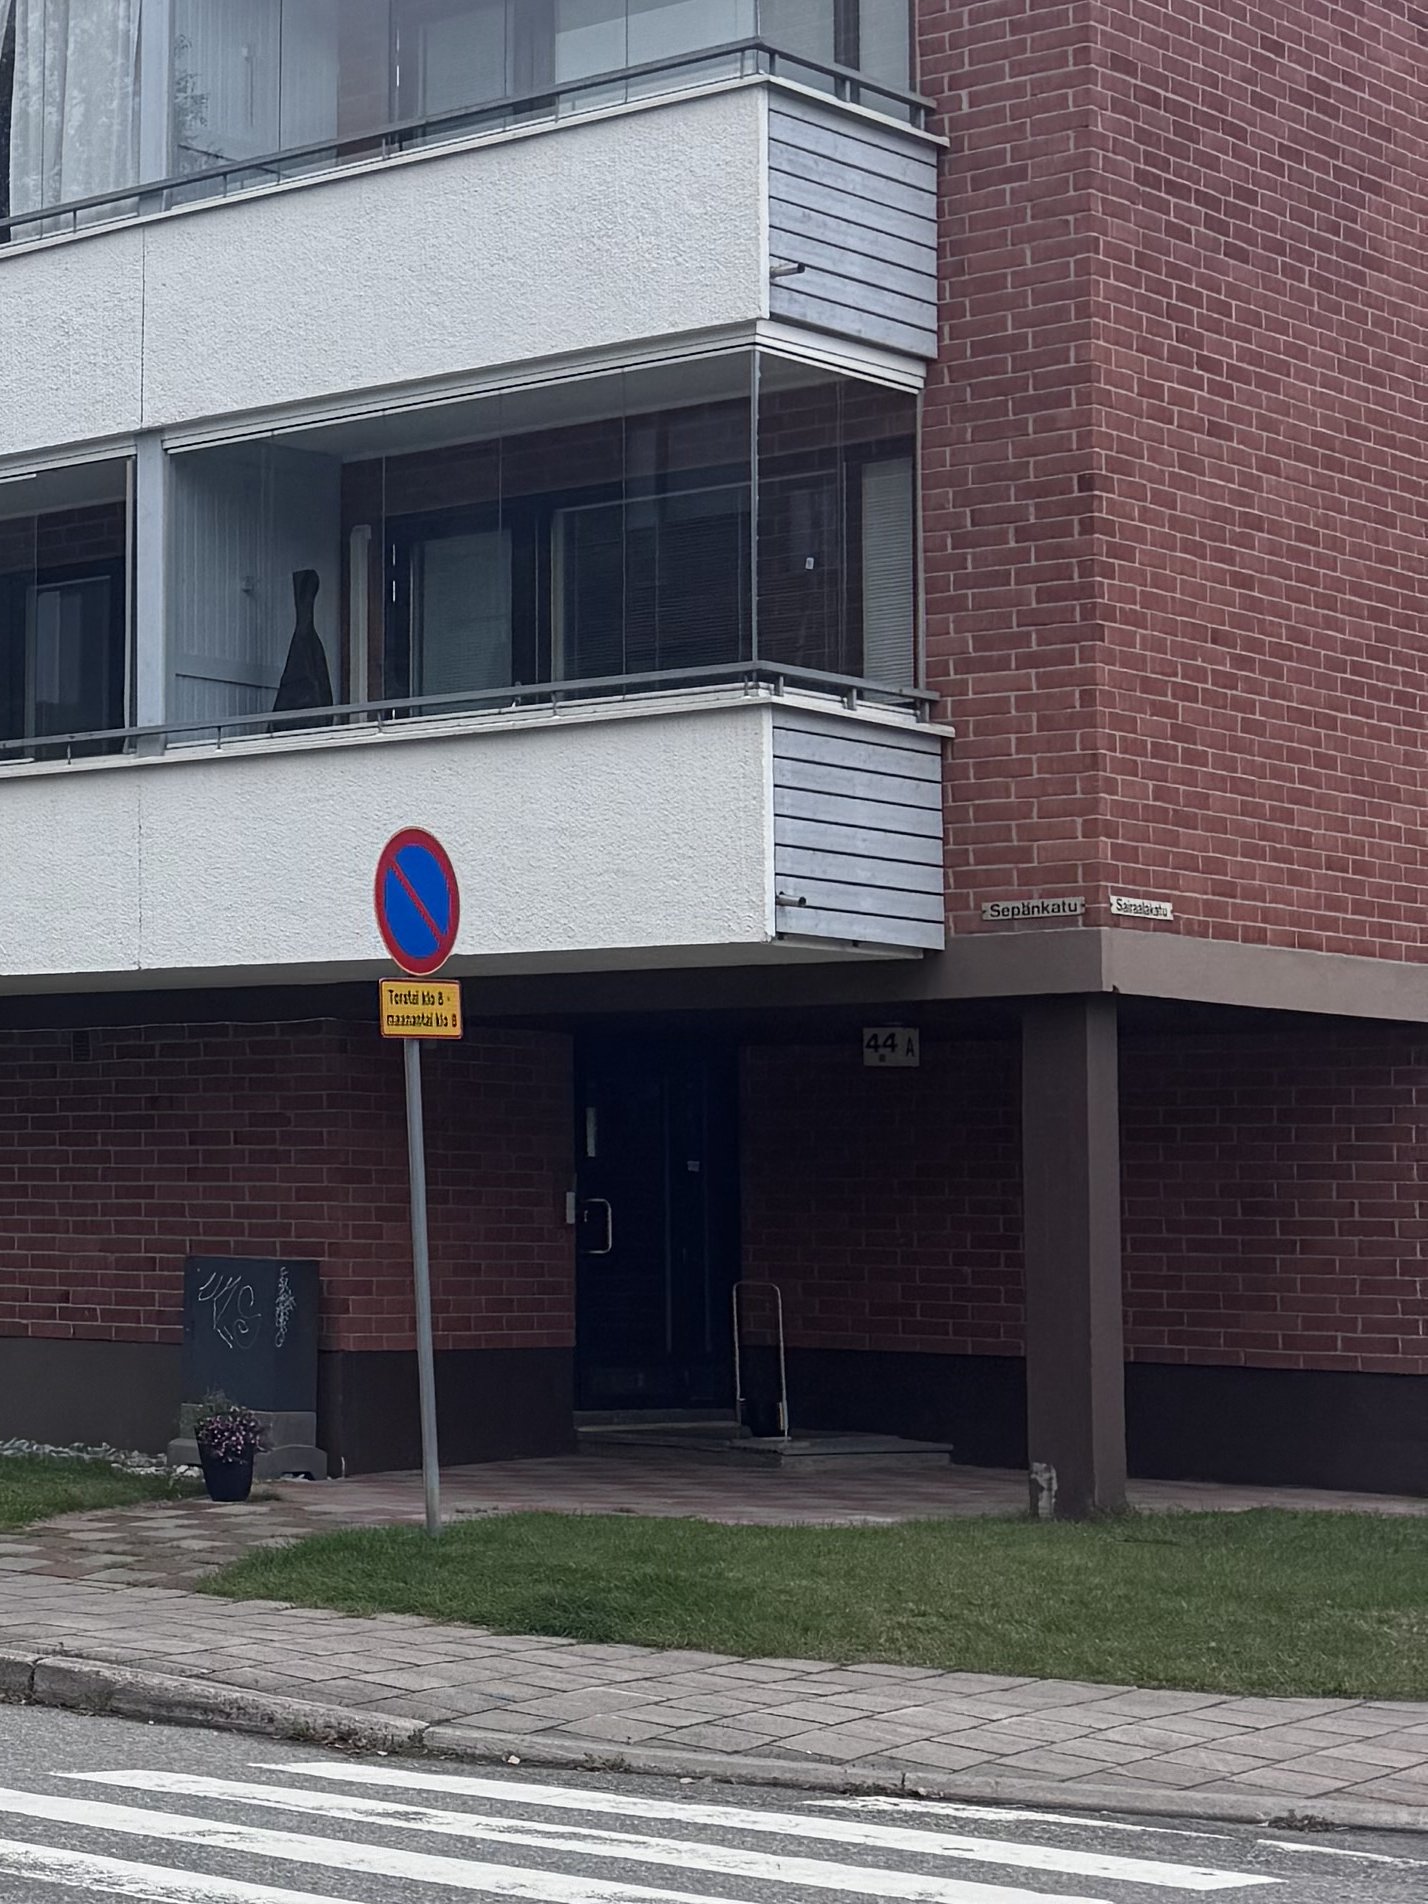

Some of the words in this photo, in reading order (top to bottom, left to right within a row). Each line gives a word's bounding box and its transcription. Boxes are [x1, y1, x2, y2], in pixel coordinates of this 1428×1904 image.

[989, 900, 1078, 919] Sepänkatu
[1116, 898, 1168, 918] Sairaalakatu
[437, 991, 444, 1006] 8
[451, 1013, 458, 1028] 8
[865, 1032, 898, 1053] 44
[906, 1036, 915, 1057] A
